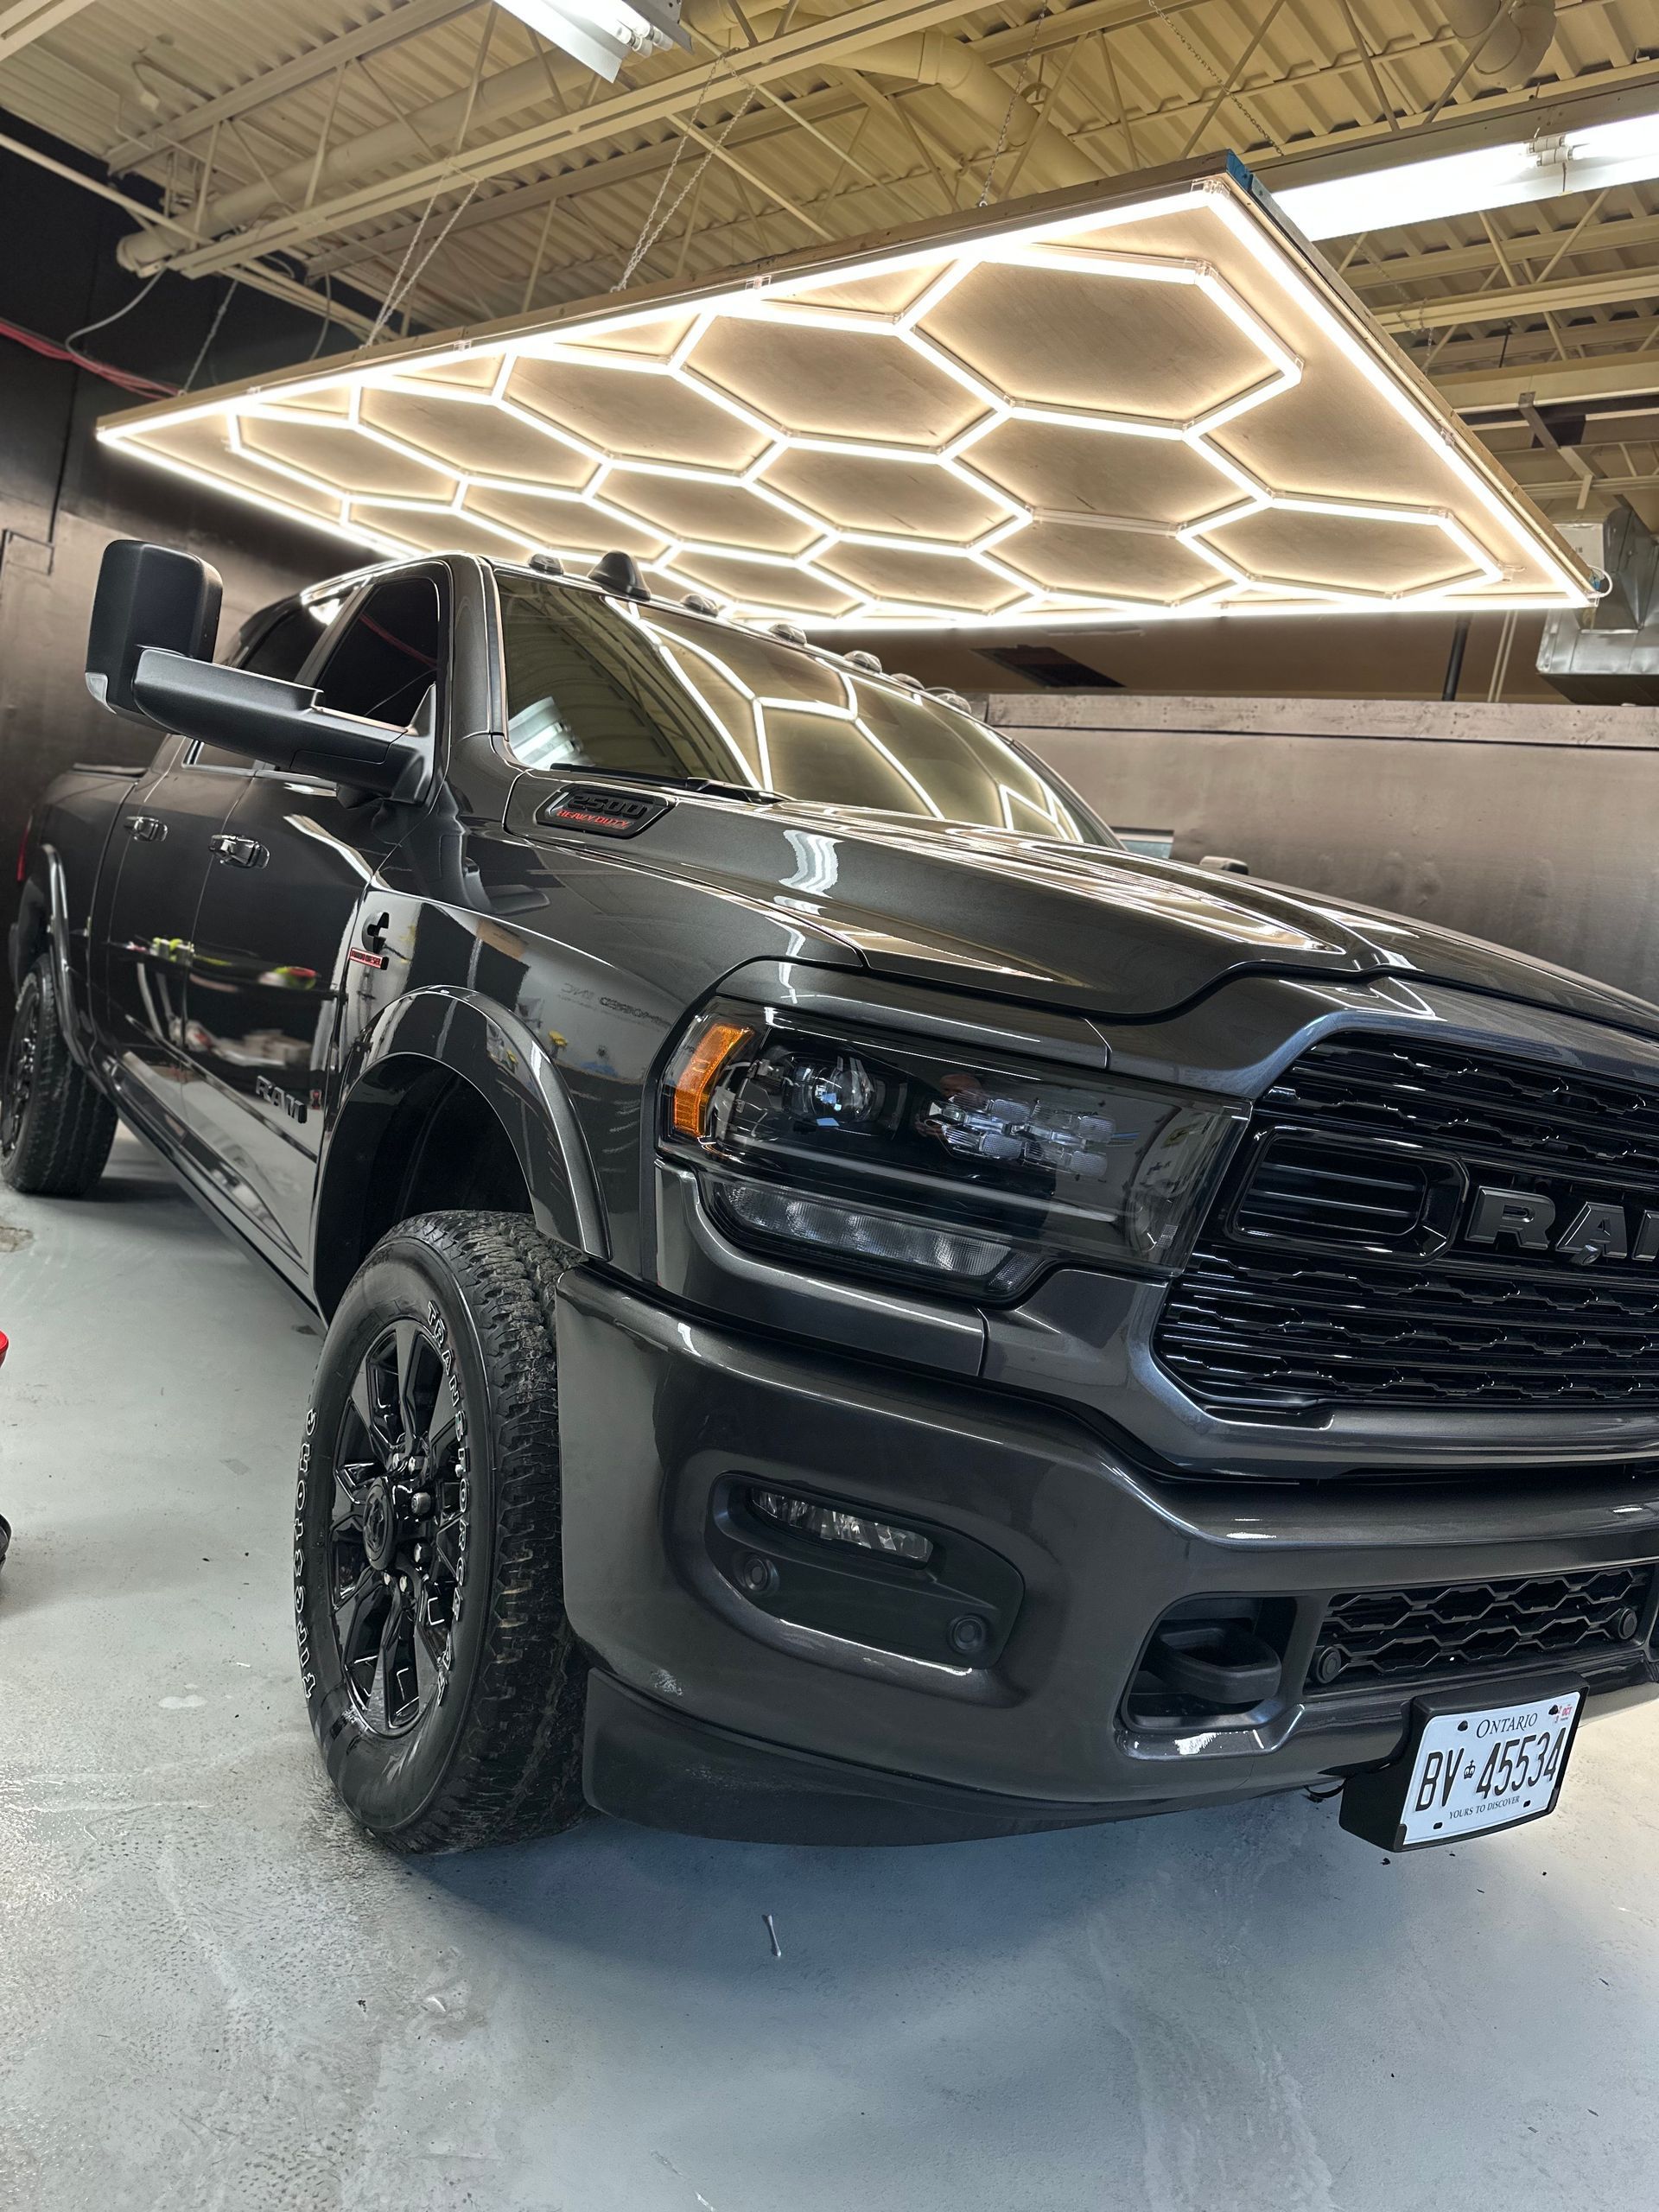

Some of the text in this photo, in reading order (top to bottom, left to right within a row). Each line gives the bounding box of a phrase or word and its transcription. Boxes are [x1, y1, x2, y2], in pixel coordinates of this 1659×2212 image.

[568, 794, 648, 819] 2500
[556, 809, 632, 830] HEAVY DUTY
[256, 1075, 308, 1124] RAM
[1476, 1713, 1538, 1738] ONTARIO
[1414, 1727, 1566, 1812] BV 45534
[1448, 1795, 1521, 1820] YOURS TO DISCOVER
